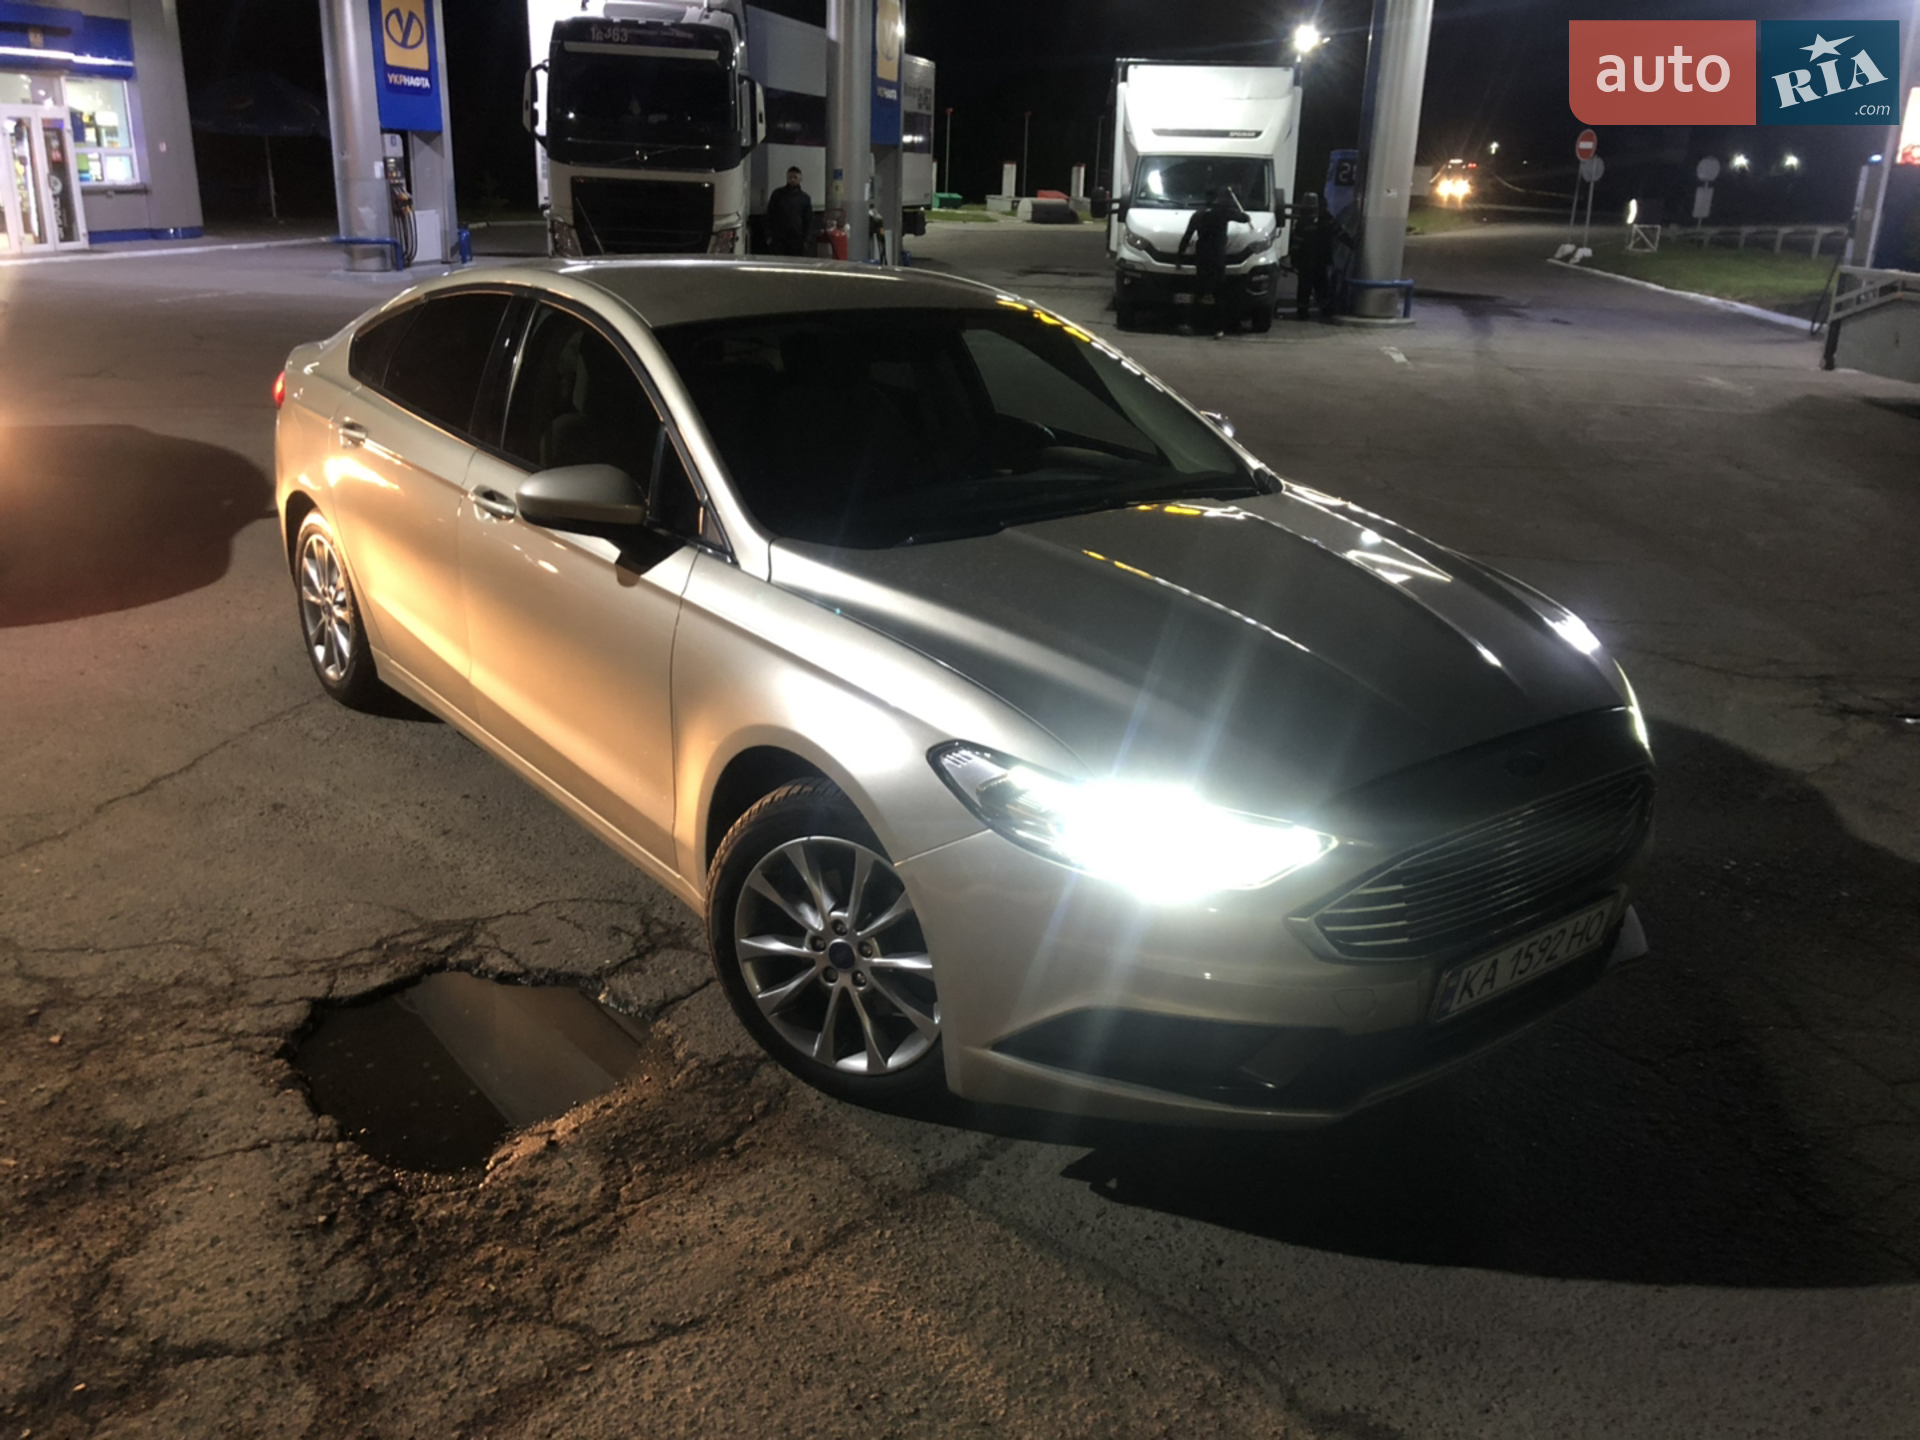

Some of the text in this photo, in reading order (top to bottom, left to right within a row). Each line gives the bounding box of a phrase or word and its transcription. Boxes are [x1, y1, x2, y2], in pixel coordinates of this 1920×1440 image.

[387, 73, 431, 89] УКРНАФТА
[1457, 910, 1605, 1005] KA 1592 HO
